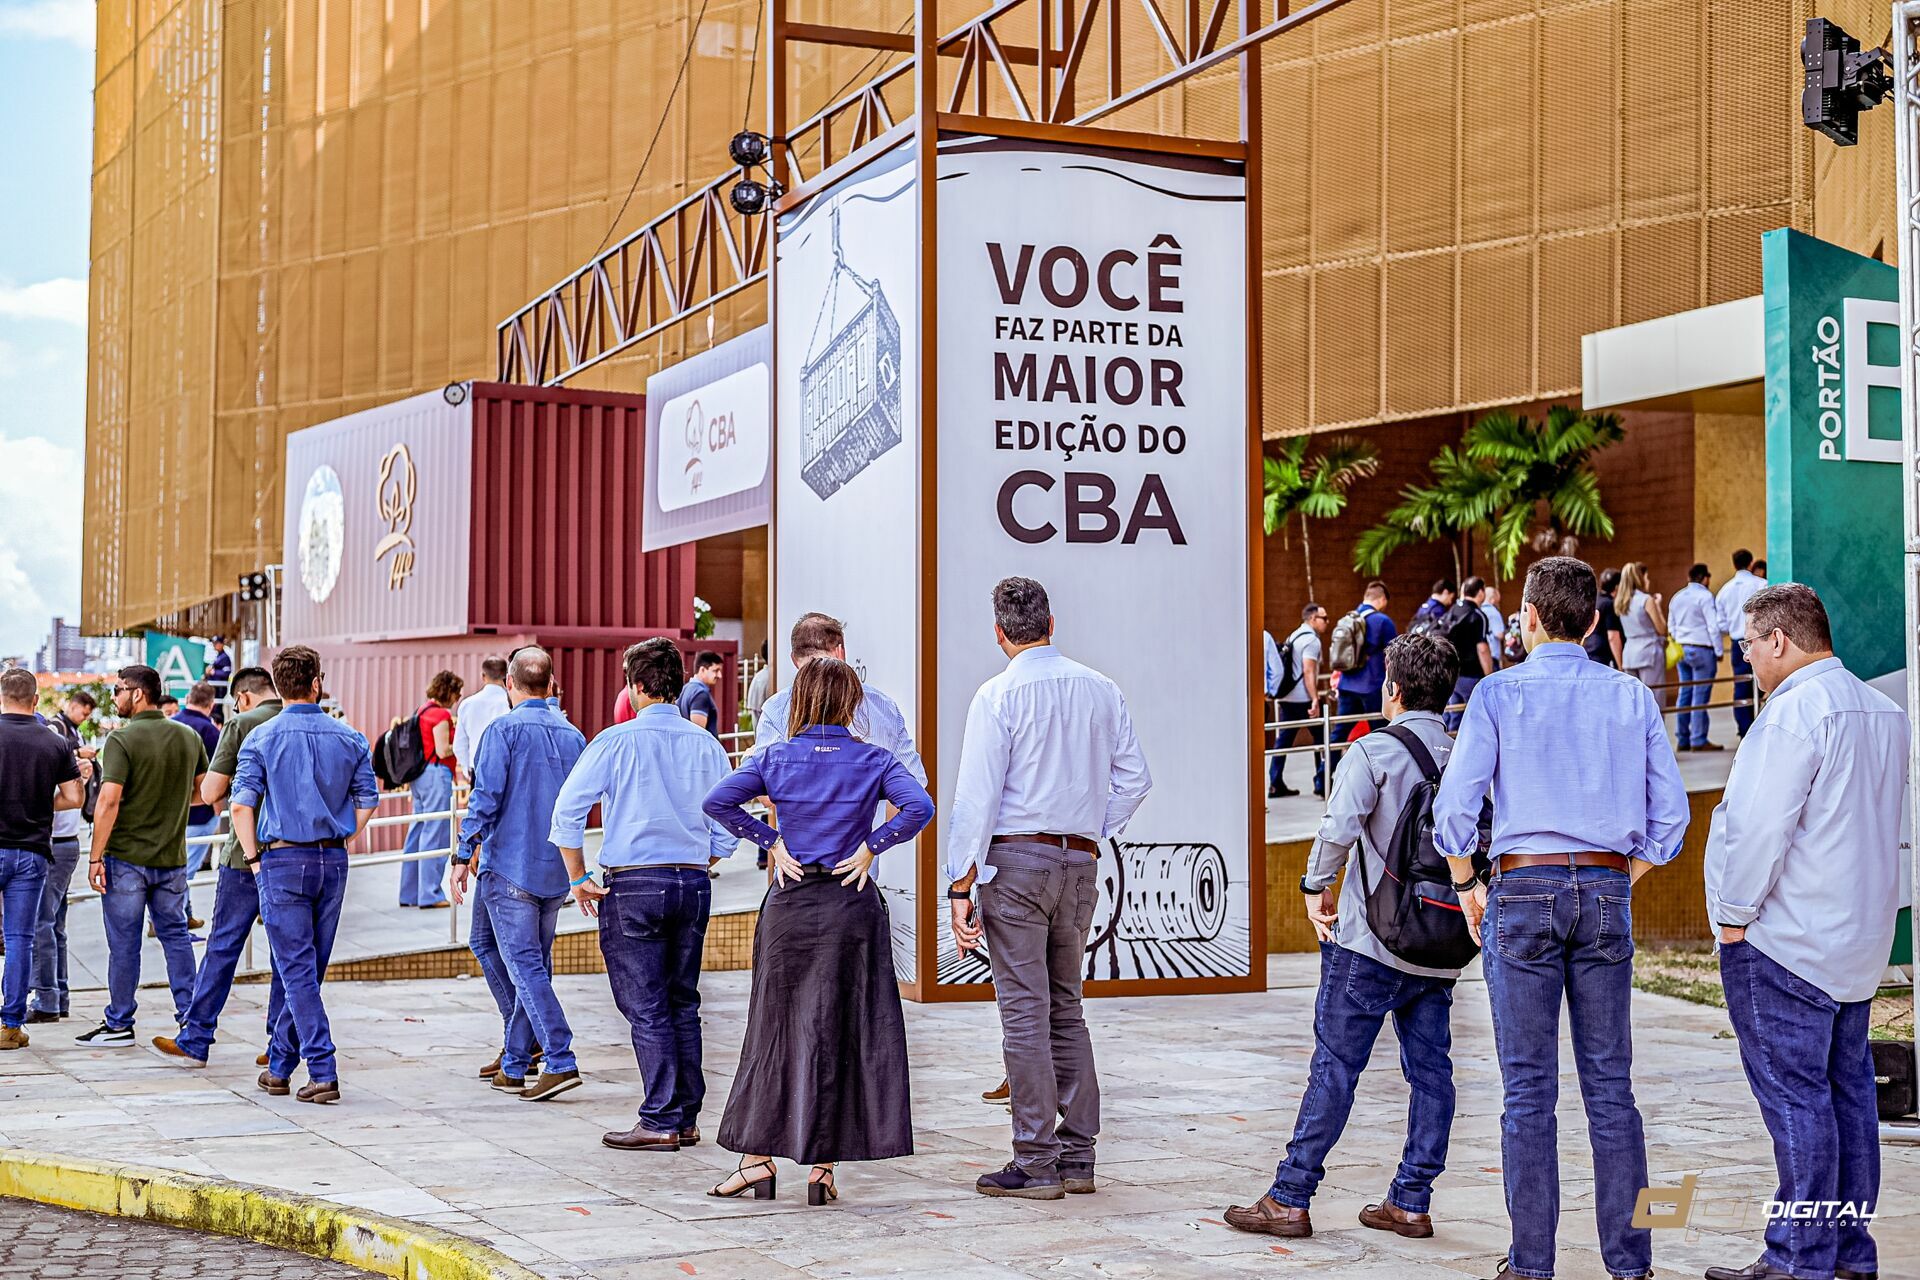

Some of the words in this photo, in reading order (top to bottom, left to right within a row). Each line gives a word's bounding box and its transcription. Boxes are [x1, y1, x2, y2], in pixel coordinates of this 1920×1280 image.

[986, 234, 1184, 313] VOCÊ
[995, 316, 1044, 341] FAZ
[1053, 318, 1139, 346] PARTE
[1148, 323, 1184, 347] DA
[994, 352, 1186, 407] MAIOR
[1812, 316, 1842, 461] PORTÃO
[708, 411, 736, 452] CBA
[995, 414, 1127, 461] EDIÇÃO
[1138, 425, 1187, 455] DO
[996, 469, 1188, 546] CBA
